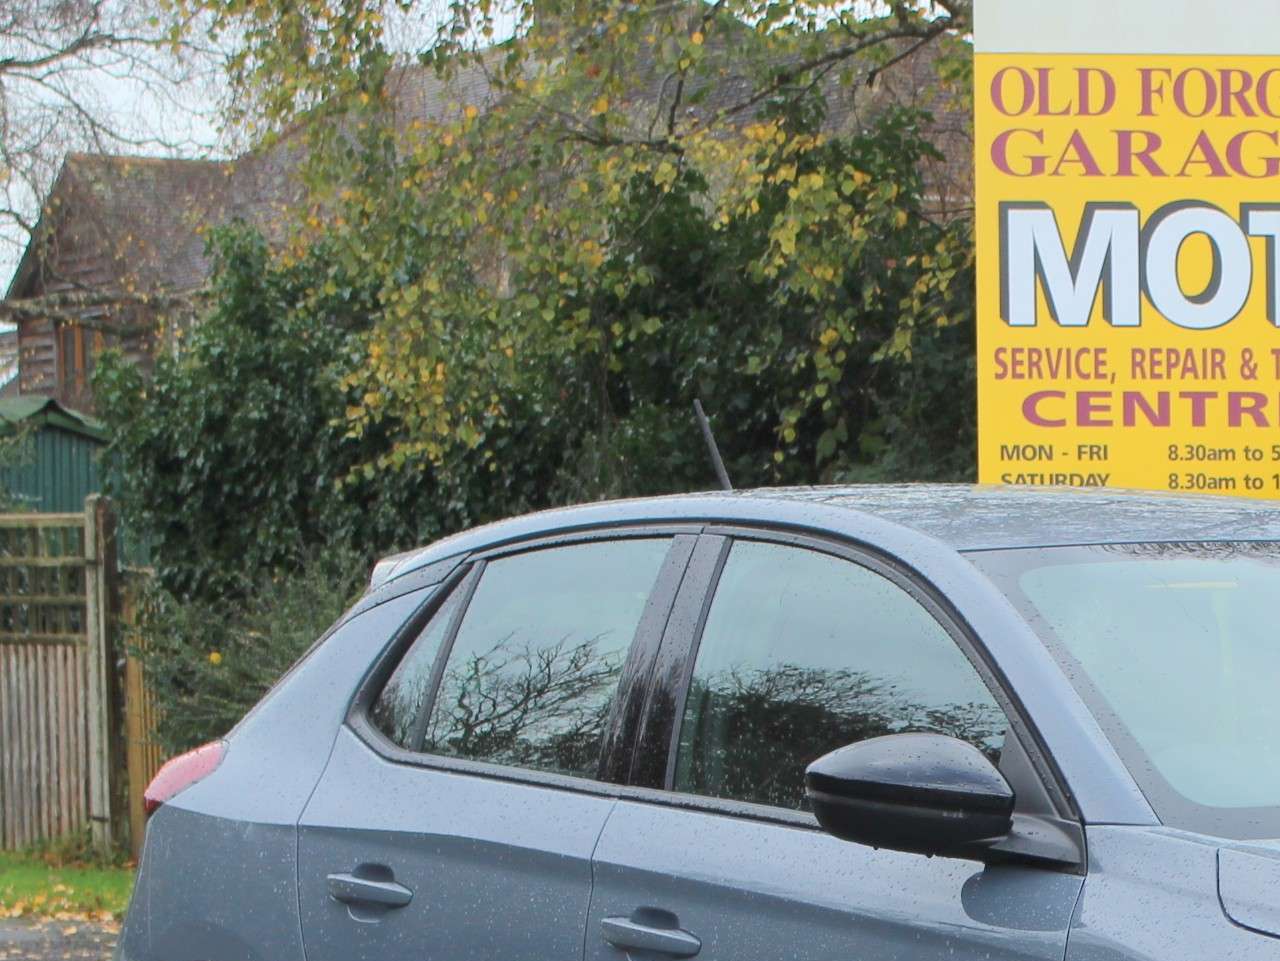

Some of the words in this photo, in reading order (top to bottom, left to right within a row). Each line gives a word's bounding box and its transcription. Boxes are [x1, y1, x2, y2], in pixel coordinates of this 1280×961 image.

[990, 67, 1116, 116] OLD
[994, 347, 1116, 385] SERVICE,
[1131, 347, 1226, 380] REPAIR
[1240, 347, 1258, 380] &
[1000, 444, 1054, 462] MON
[1077, 444, 1108, 461] FRI
[1168, 444, 1236, 462] 8.30am
[1243, 445, 1264, 462] to
[1000, 473, 1111, 487] SATURDAY
[1168, 472, 1237, 491] 8.30am
[1243, 473, 1265, 491] to
